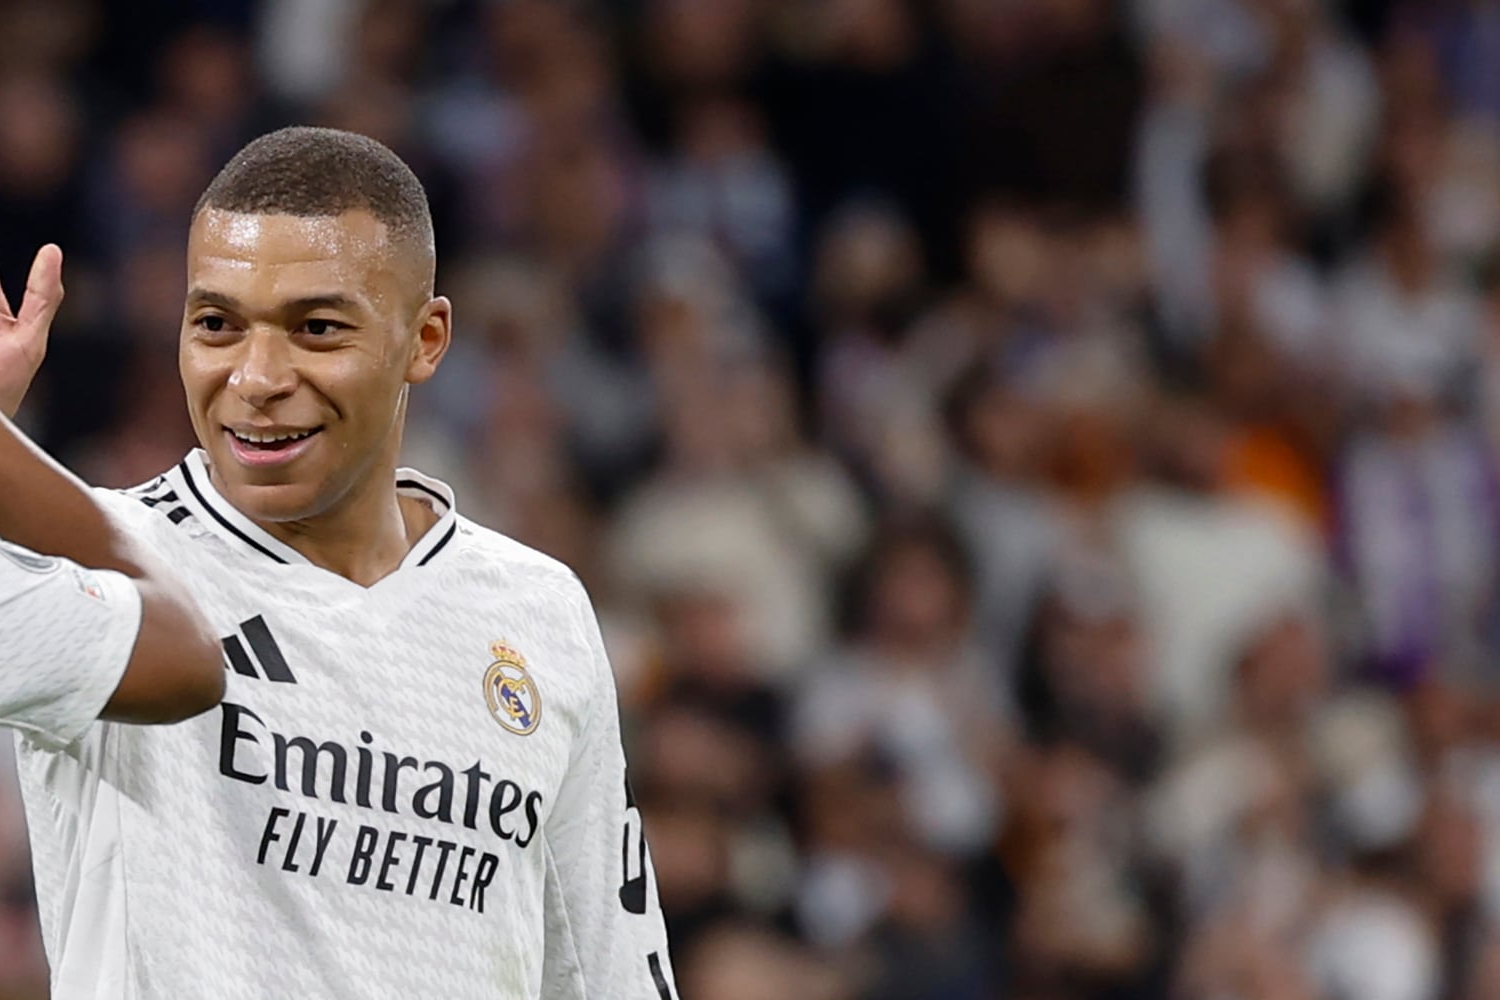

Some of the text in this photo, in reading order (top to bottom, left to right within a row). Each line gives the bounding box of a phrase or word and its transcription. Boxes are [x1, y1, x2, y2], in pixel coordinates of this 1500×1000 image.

[218, 702, 544, 849] Emirates
[256, 806, 500, 914] FLY BETTER
